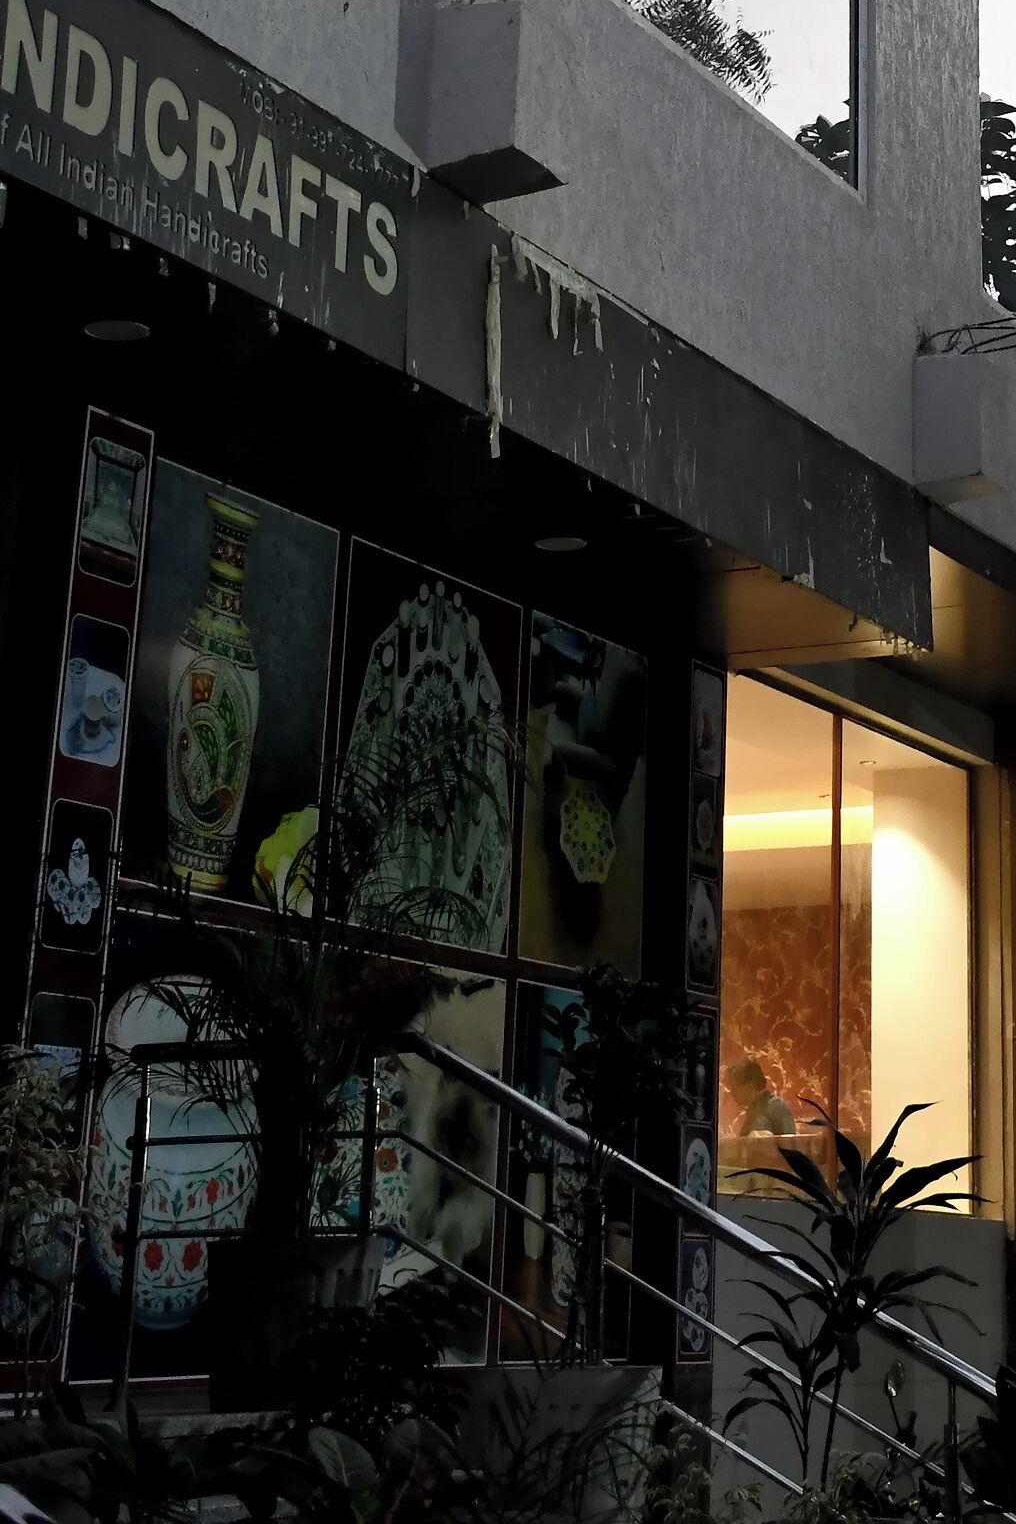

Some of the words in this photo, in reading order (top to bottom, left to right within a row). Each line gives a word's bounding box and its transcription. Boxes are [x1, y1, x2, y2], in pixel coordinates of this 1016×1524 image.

[15, 123, 52, 167] All
[58, 142, 135, 211] Indian
[142, 184, 269, 279] Handicrafts
